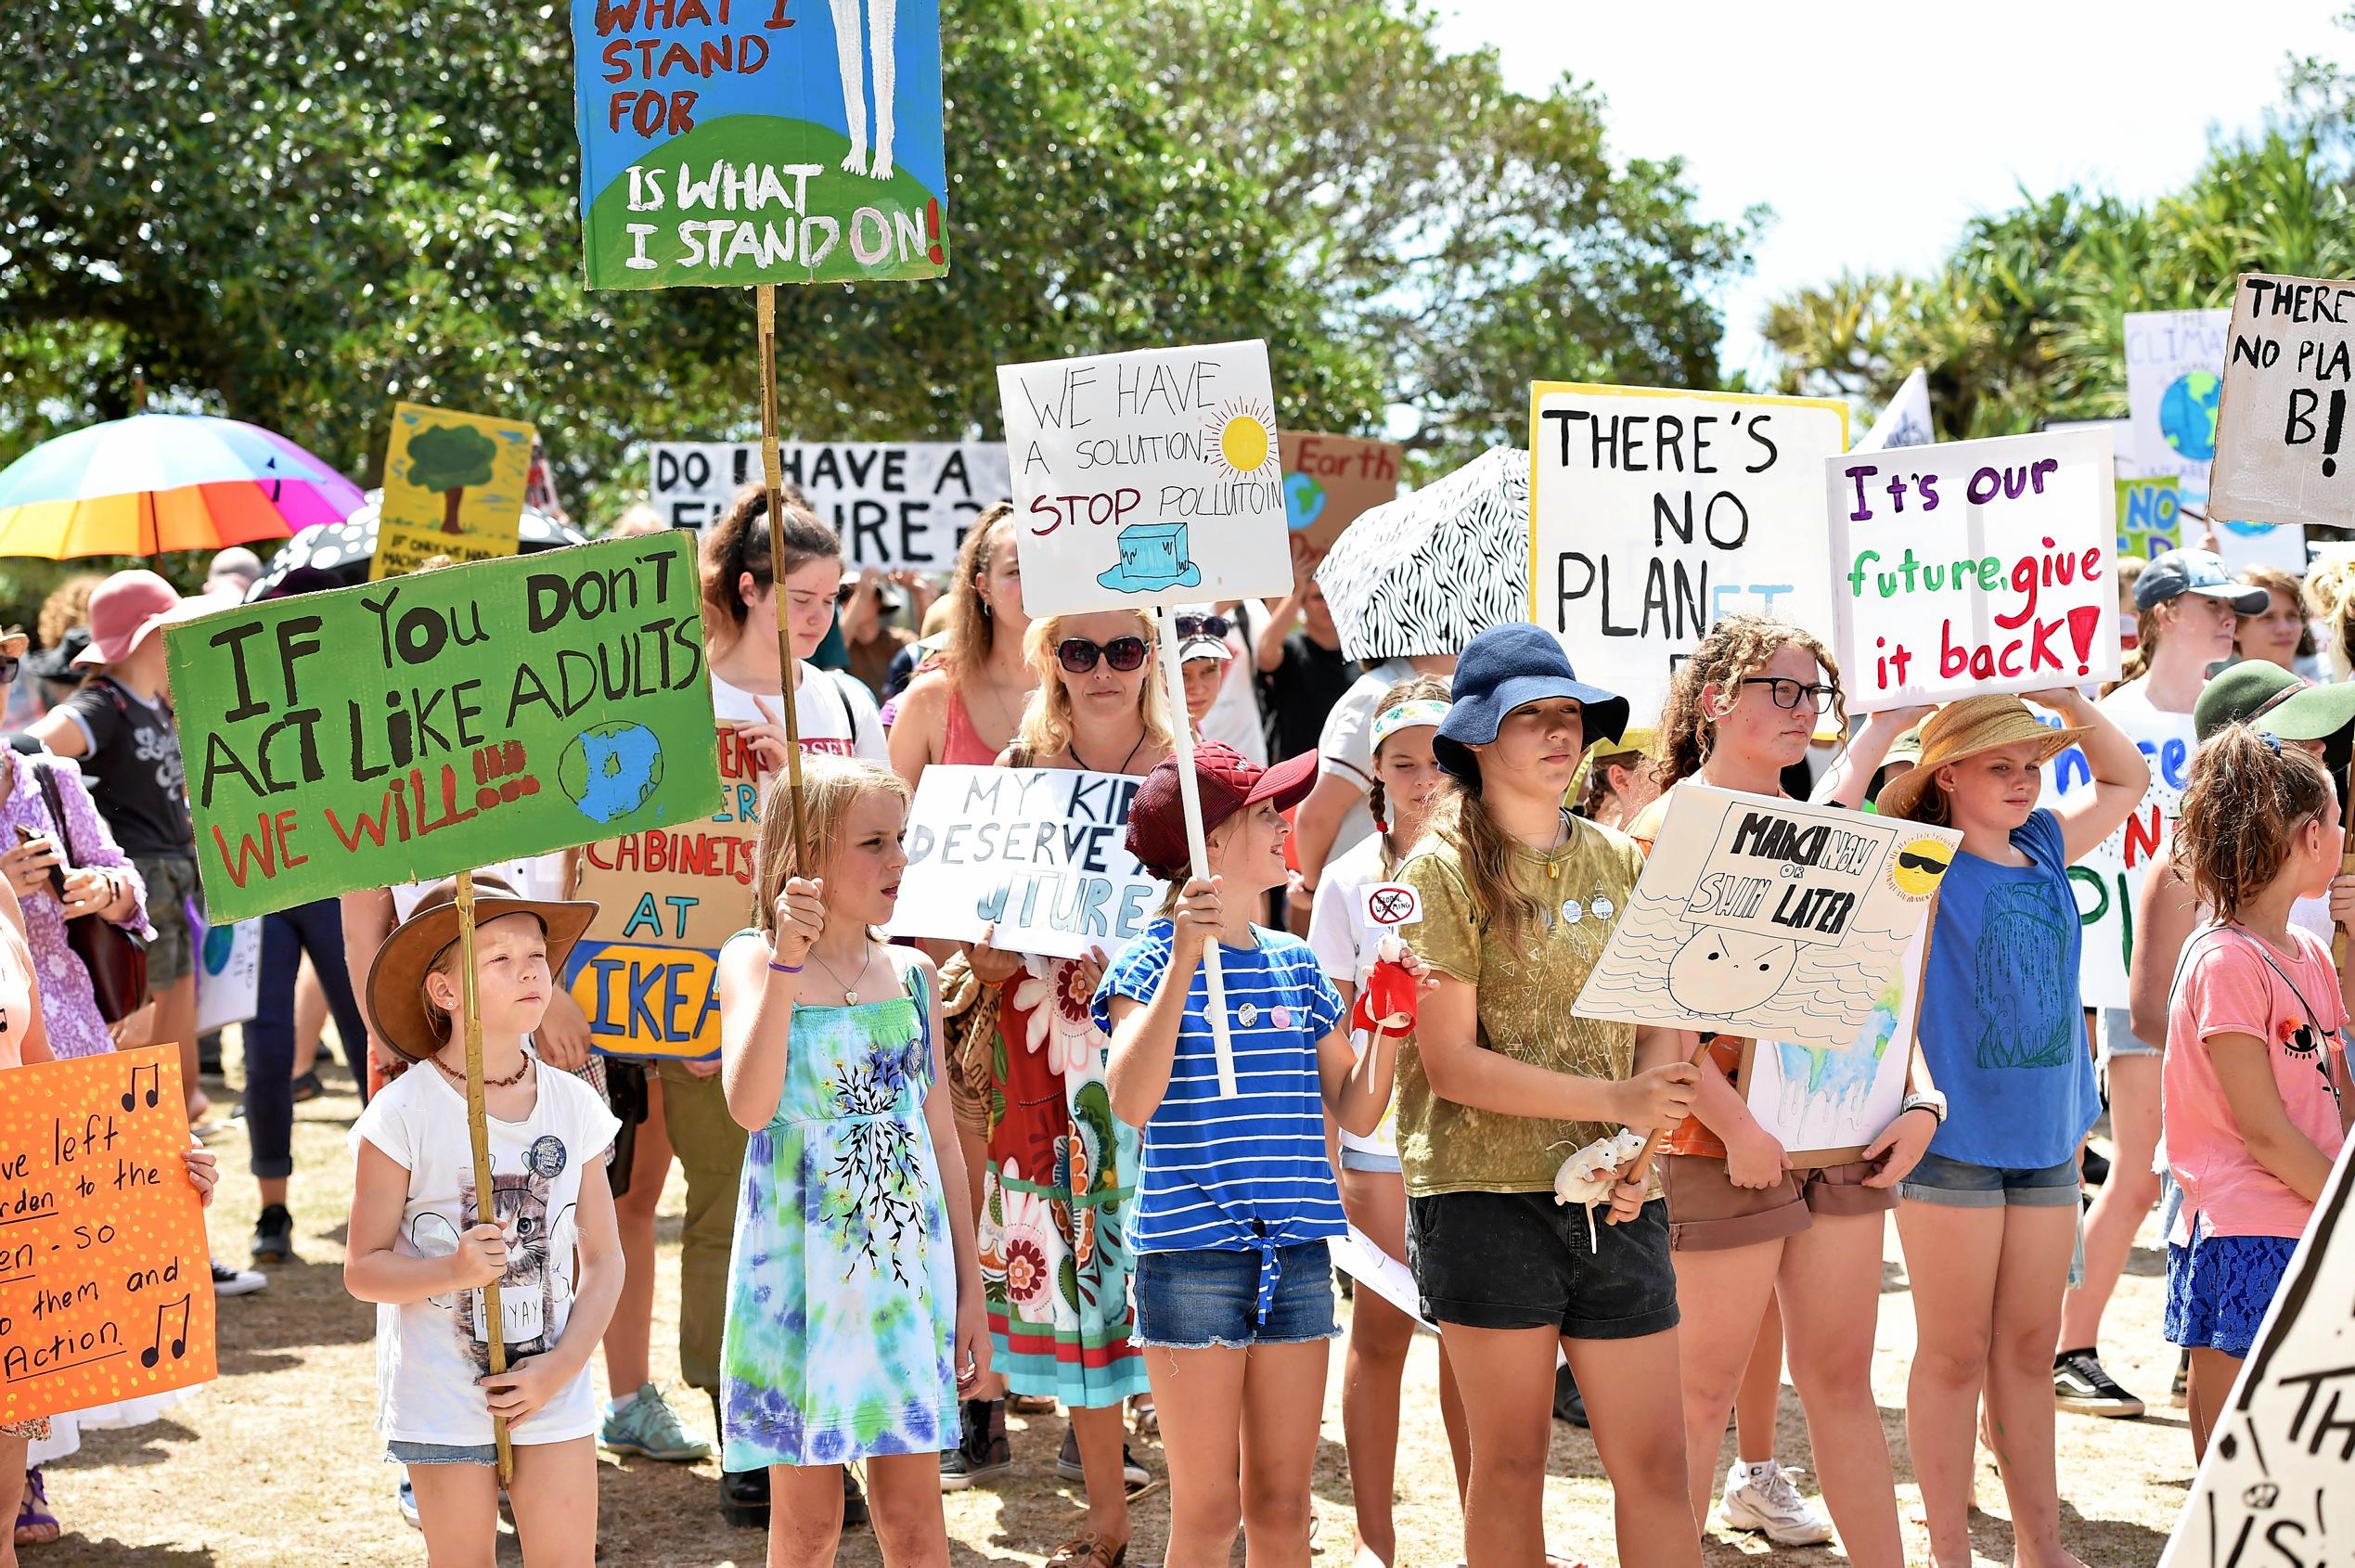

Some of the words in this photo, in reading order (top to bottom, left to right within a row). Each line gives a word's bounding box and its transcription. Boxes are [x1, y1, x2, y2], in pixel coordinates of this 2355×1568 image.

[595, 0, 729, 36] WHAT
[602, 34, 769, 84] STAND
[609, 89, 700, 138] FOR
[624, 165, 665, 212] IS
[676, 159, 824, 217] WHAT
[624, 223, 659, 269] I
[676, 215, 840, 270] STAND
[849, 197, 946, 265] ON!
[2246, 278, 2355, 324] THERE
[2233, 334, 2280, 369] NO
[1021, 366, 1097, 430] WE
[1117, 360, 1222, 418] HAVE
[1024, 441, 1050, 475] A
[1076, 429, 1209, 469] SOLUTION,
[1296, 438, 1395, 481] Earth
[1542, 409, 1778, 474] THERE'S
[2284, 388, 2347, 478] B!
[657, 449, 711, 493] DO
[733, 449, 749, 484] I
[779, 448, 907, 493] HAVE
[933, 449, 972, 496] A
[1845, 466, 1940, 521] It's
[1030, 487, 1141, 536] STOP
[1159, 480, 1283, 517] POLLUTOIN
[1654, 490, 1749, 550] NO
[2126, 487, 2180, 531] NO
[1994, 535, 2104, 630] give
[209, 615, 323, 725] IF
[1876, 636, 1912, 689] it
[1939, 605, 2101, 680] back!
[201, 708, 325, 810] ACT
[505, 615, 702, 728] ADULTS
[962, 772, 1049, 816] MY
[212, 808, 309, 889] WE
[586, 829, 758, 886] CABINETS
[907, 821, 1115, 873] DESERVE
[1731, 812, 1832, 867] MARCH
[1820, 829, 1879, 877] NOW
[1779, 864, 1805, 880] OR
[623, 892, 700, 939] AT
[1689, 872, 1772, 919] SWIM
[1770, 883, 1857, 935] LATER
[54, 1113, 120, 1166] left
[75, 1174, 97, 1199] to
[113, 1158, 161, 1192] the
[73, 1224, 116, 1251] so
[32, 1280, 100, 1321] them
[126, 1255, 179, 1293] and
